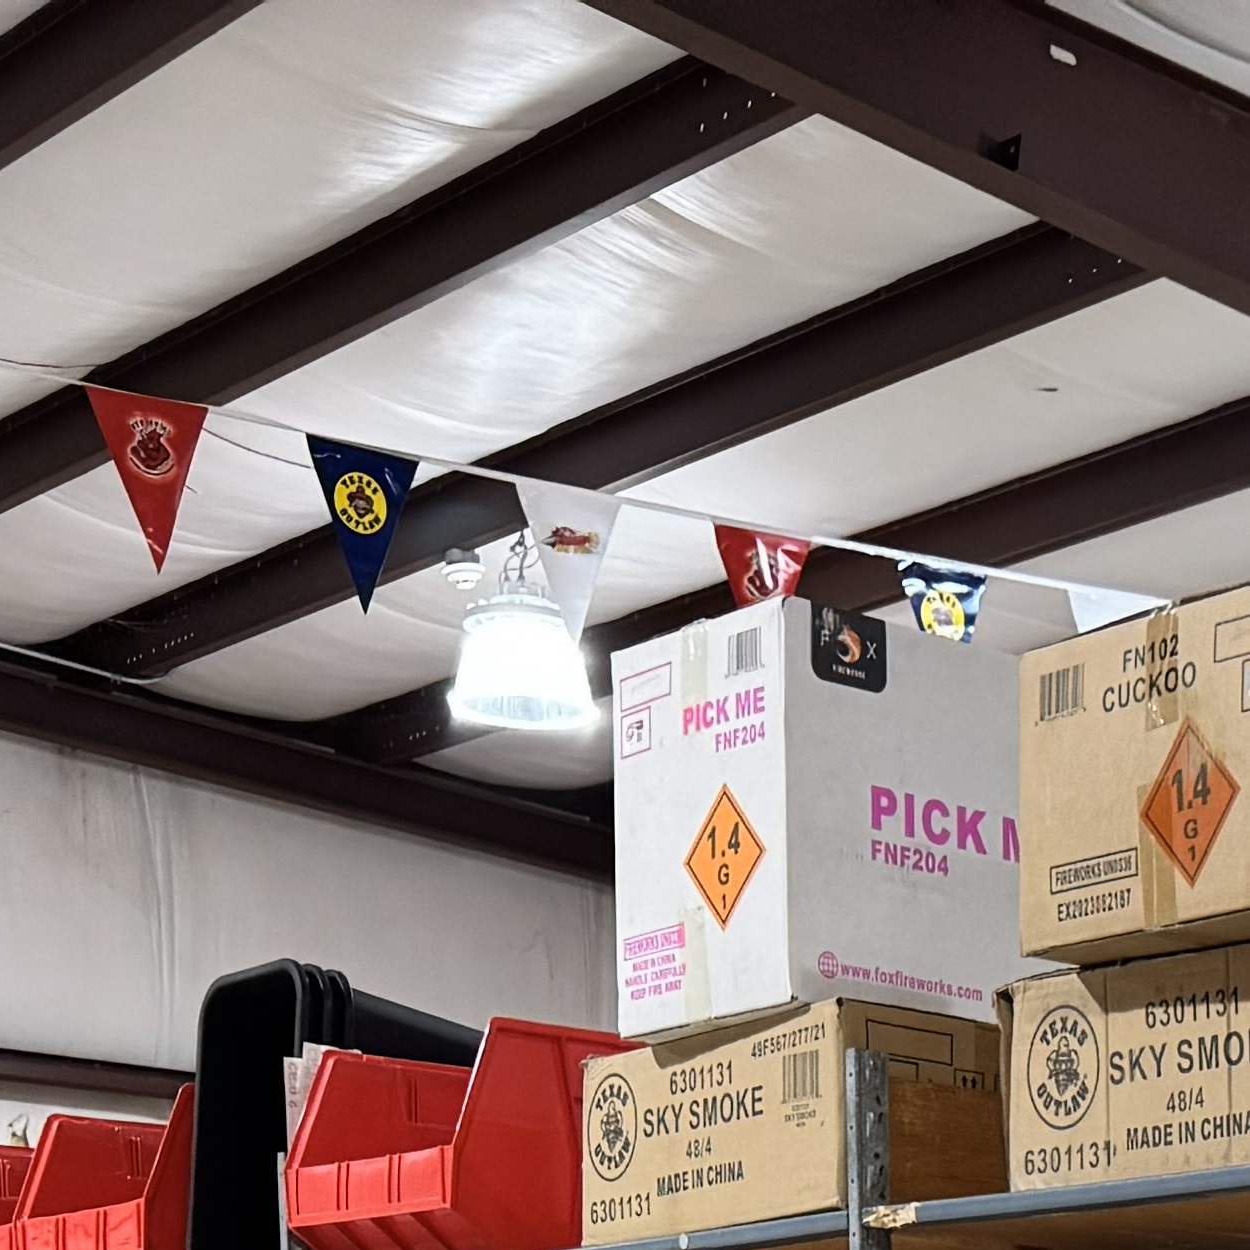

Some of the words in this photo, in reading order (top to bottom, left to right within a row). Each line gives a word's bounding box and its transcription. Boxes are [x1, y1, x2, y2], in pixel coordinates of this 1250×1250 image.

[1122, 633, 1180, 673] FN102
[1102, 661, 1197, 713] CUCKOO
[682, 695, 730, 736] PICK
[735, 686, 766, 719] ME
[714, 721, 766, 753] FNF204
[1171, 762, 1211, 813] 1.4
[870, 784, 987, 856] PICK
[1183, 818, 1198, 840] G
[707, 821, 741, 860] 1.4
[870, 839, 950, 878] FNF204
[717, 864, 730, 886] G
[722, 893, 727, 910] 1
[840, 962, 983, 1002] www.foxfireworks.com
[1144, 986, 1239, 1029] 6301131
[1040, 1016, 1089, 1047] TEXAS
[1109, 1043, 1167, 1086] SKY
[1177, 1029, 1250, 1074] SMO
[669, 1060, 733, 1096] 6301131
[595, 1083, 629, 1112] TEXAS
[643, 1102, 684, 1139] SKY
[689, 1085, 764, 1130] SMOKE
[1036, 1080, 1090, 1117] OUTLAW
[1166, 1087, 1205, 1113] 48/4
[594, 1134, 632, 1171] OUTLAW
[686, 1136, 713, 1160] 48/4
[1126, 1123, 1173, 1151] MADE
[1178, 1120, 1196, 1145] IN
[1024, 1139, 1112, 1176] 6301131
[657, 1171, 689, 1197] MADE
[692, 1167, 704, 1190] IN
[707, 1161, 745, 1188] CHINA
[590, 1192, 651, 1225] 6301131
